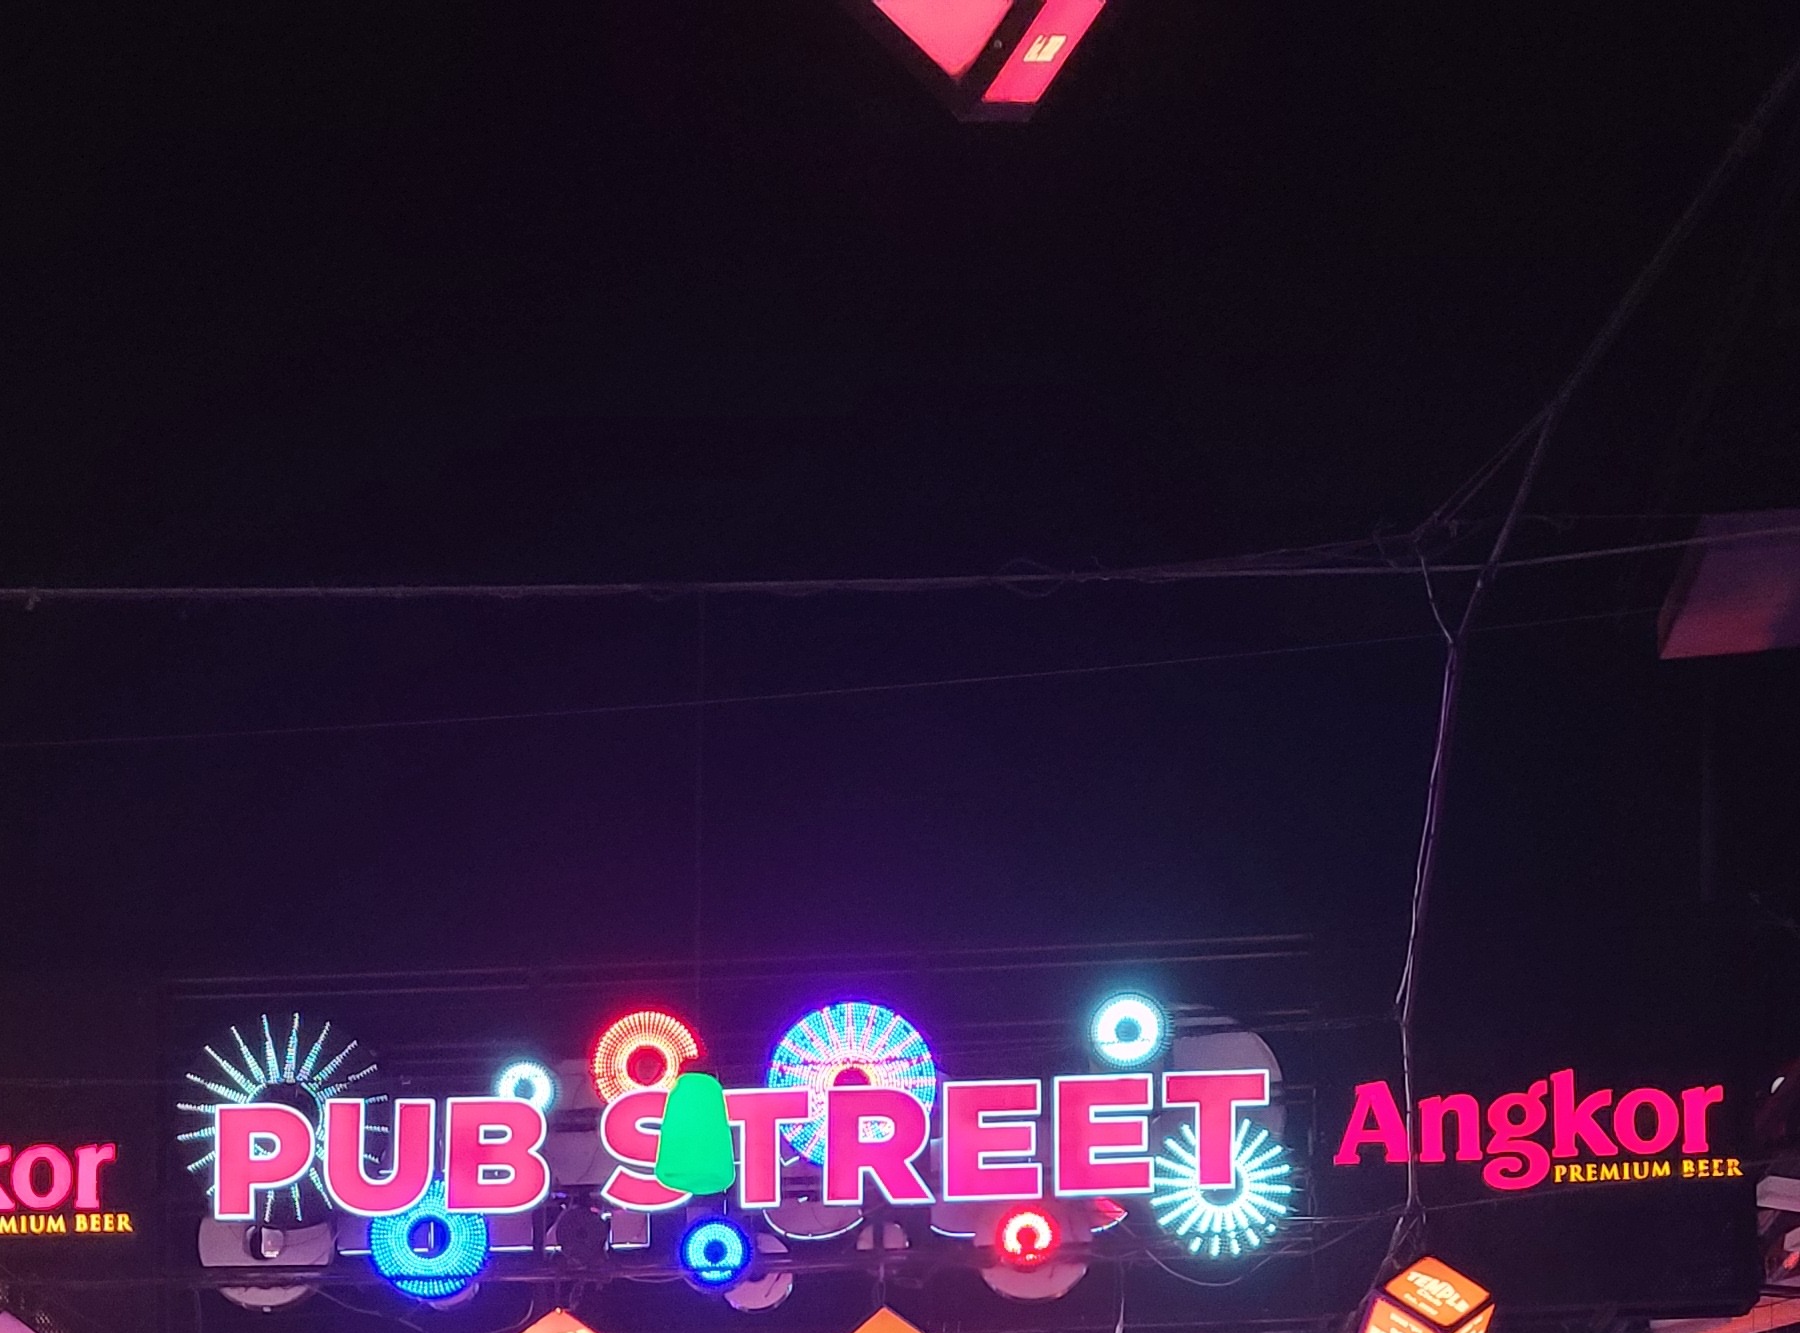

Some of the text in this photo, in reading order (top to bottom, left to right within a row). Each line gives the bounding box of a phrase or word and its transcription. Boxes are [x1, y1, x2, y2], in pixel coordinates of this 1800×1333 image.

[212, 1069, 1270, 1220] PUB STREET
[1333, 1068, 1724, 1191] Angkor
[1554, 1158, 1744, 1184] PREMIUM BEER
[75, 1214, 133, 1235] BEER
[1407, 1271, 1470, 1314] TEMPLE
